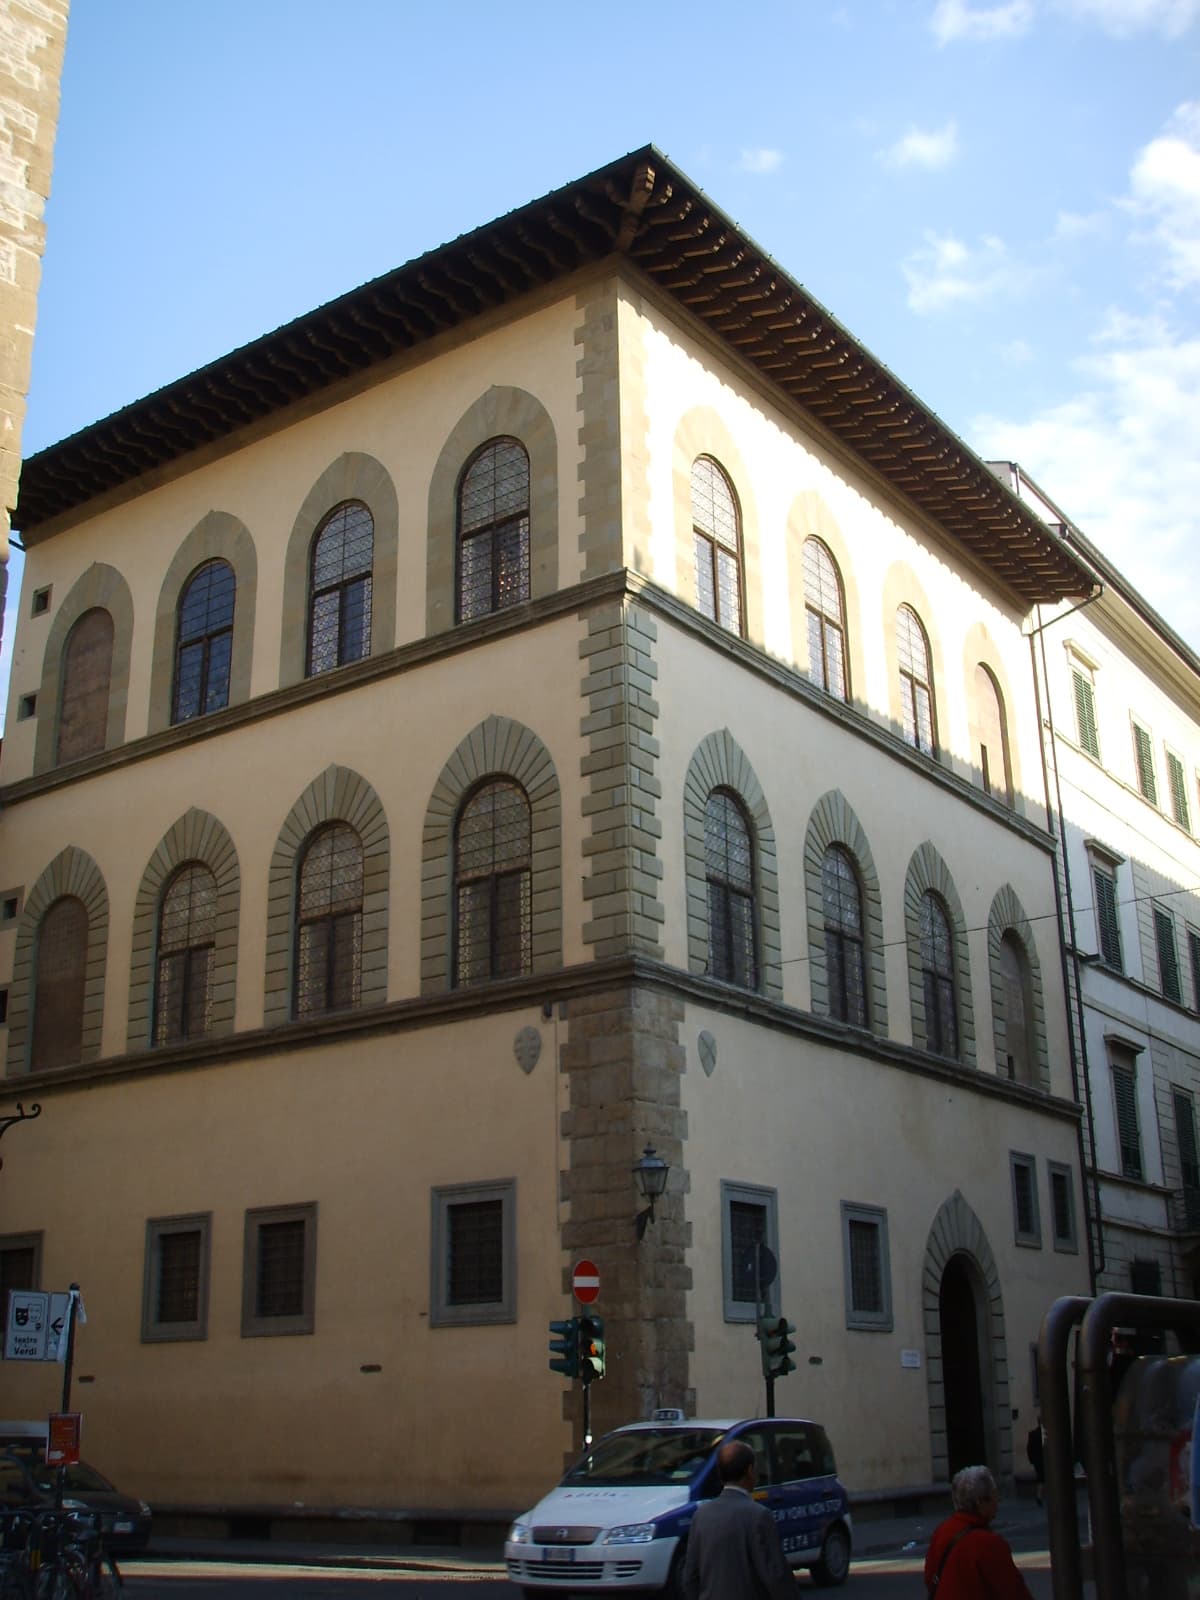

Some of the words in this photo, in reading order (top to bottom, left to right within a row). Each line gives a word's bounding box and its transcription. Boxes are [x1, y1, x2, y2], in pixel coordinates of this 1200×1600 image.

[14, 1347, 37, 1356] Verdi
[786, 1506, 806, 1519] YORK
[783, 1535, 809, 1550] ELTA
